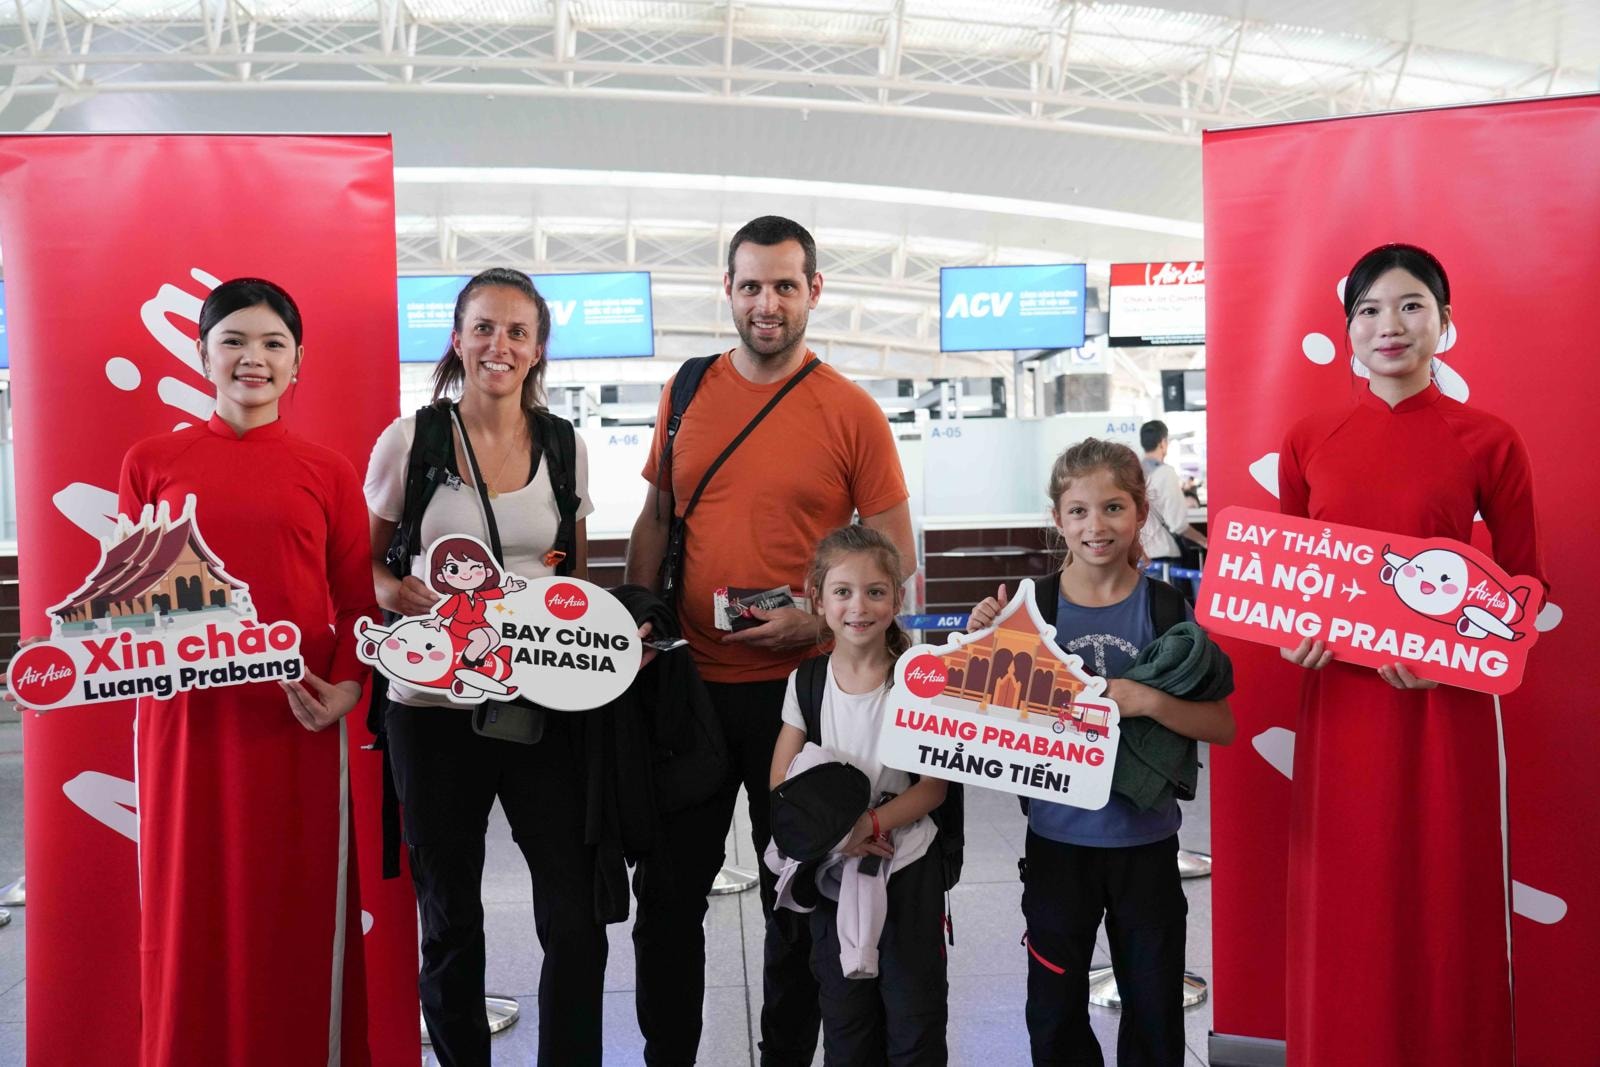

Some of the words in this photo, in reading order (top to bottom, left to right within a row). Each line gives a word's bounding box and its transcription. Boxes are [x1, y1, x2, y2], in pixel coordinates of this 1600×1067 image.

[945, 291, 1013, 318] ACV
[608, 434, 639, 446] A-06
[931, 427, 961, 438] A-05
[1105, 422, 1137, 434] A-04
[1226, 521, 1277, 546] BAY
[1281, 528, 1374, 565] THẲNG
[1218, 551, 1264, 585] HÀ
[1272, 563, 1335, 602] NỘI
[501, 622, 551, 643] BAY
[556, 625, 629, 651] CÙNG
[937, 616, 963, 626] ACV
[1209, 593, 1322, 637] LUANG
[1328, 618, 1509, 678] PRABANG
[82, 632, 166, 675] Xin
[177, 620, 297, 663] chào
[514, 647, 616, 673] AIRASIA
[84, 674, 173, 701] Luang
[180, 658, 301, 688] Prabang
[895, 708, 977, 741] LUANG
[982, 724, 1105, 767] PRABANG
[918, 743, 1003, 779] THẲNG
[1009, 763, 1071, 793] TIẾN!
